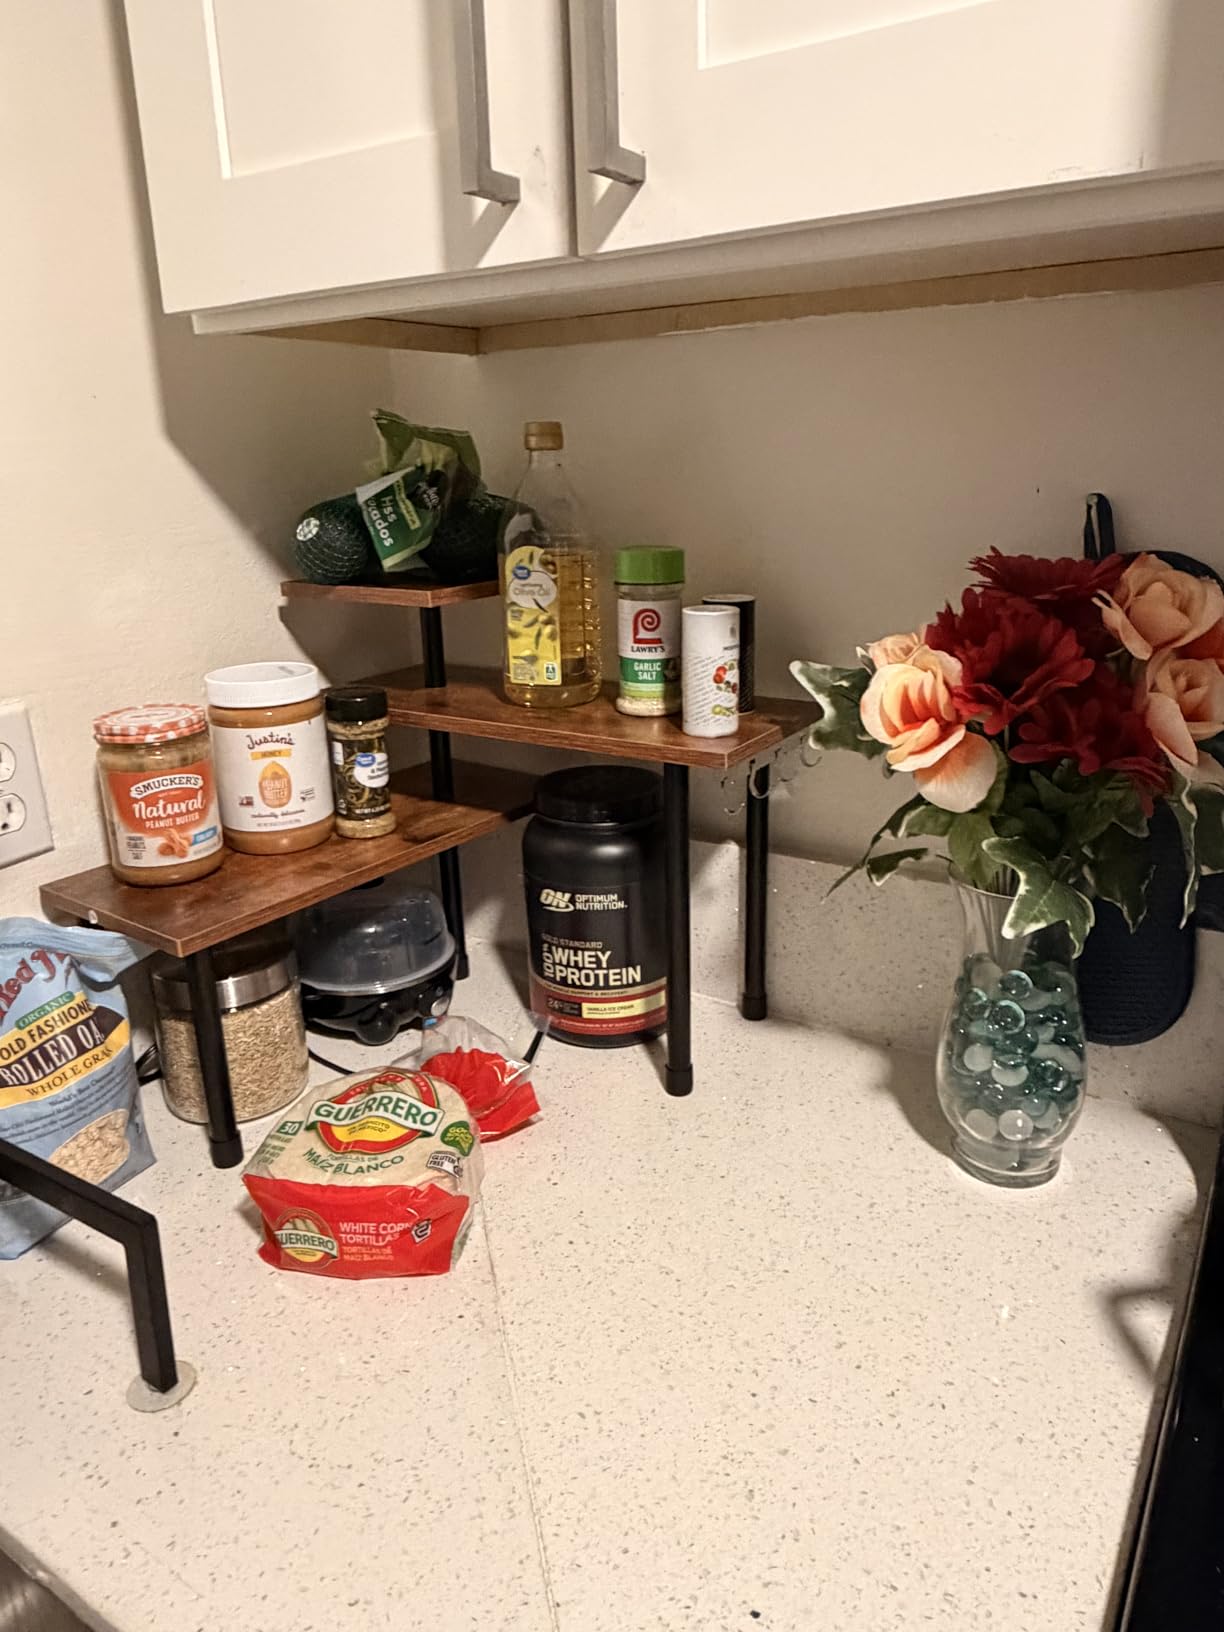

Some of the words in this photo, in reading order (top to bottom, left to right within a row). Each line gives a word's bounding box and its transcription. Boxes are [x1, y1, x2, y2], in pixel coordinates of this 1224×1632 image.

[634, 662, 661, 671] GARLIC
[638, 671, 656, 680] SALT
[245, 731, 295, 750] Justin's
[132, 789, 206, 819] Natural
[145, 817, 173, 829] PEANUT
[175, 812, 200, 826] BUTTER
[539, 888, 572, 908] ON
[574, 893, 618, 902] OPTIMUM
[575, 901, 625, 911] NUTRITION
[559, 938, 602, 949] STANDARD
[551, 946, 612, 968] WHEY
[555, 965, 641, 987] PROTEIN
[19, 995, 70, 1027] ORGANIC
[0, 1038, 26, 1061] OLD
[0, 1034, 78, 1086] ROLLED
[25, 1066, 81, 1097] WHOLE
[314, 1095, 438, 1126] GUERRERO
[280, 1122, 299, 1134] 30
[333, 1155, 404, 1175] BLANCO
[431, 1154, 456, 1165] GLUTEN
[339, 1222, 377, 1234] WHITE
[339, 1233, 400, 1246] TORTILLAS
